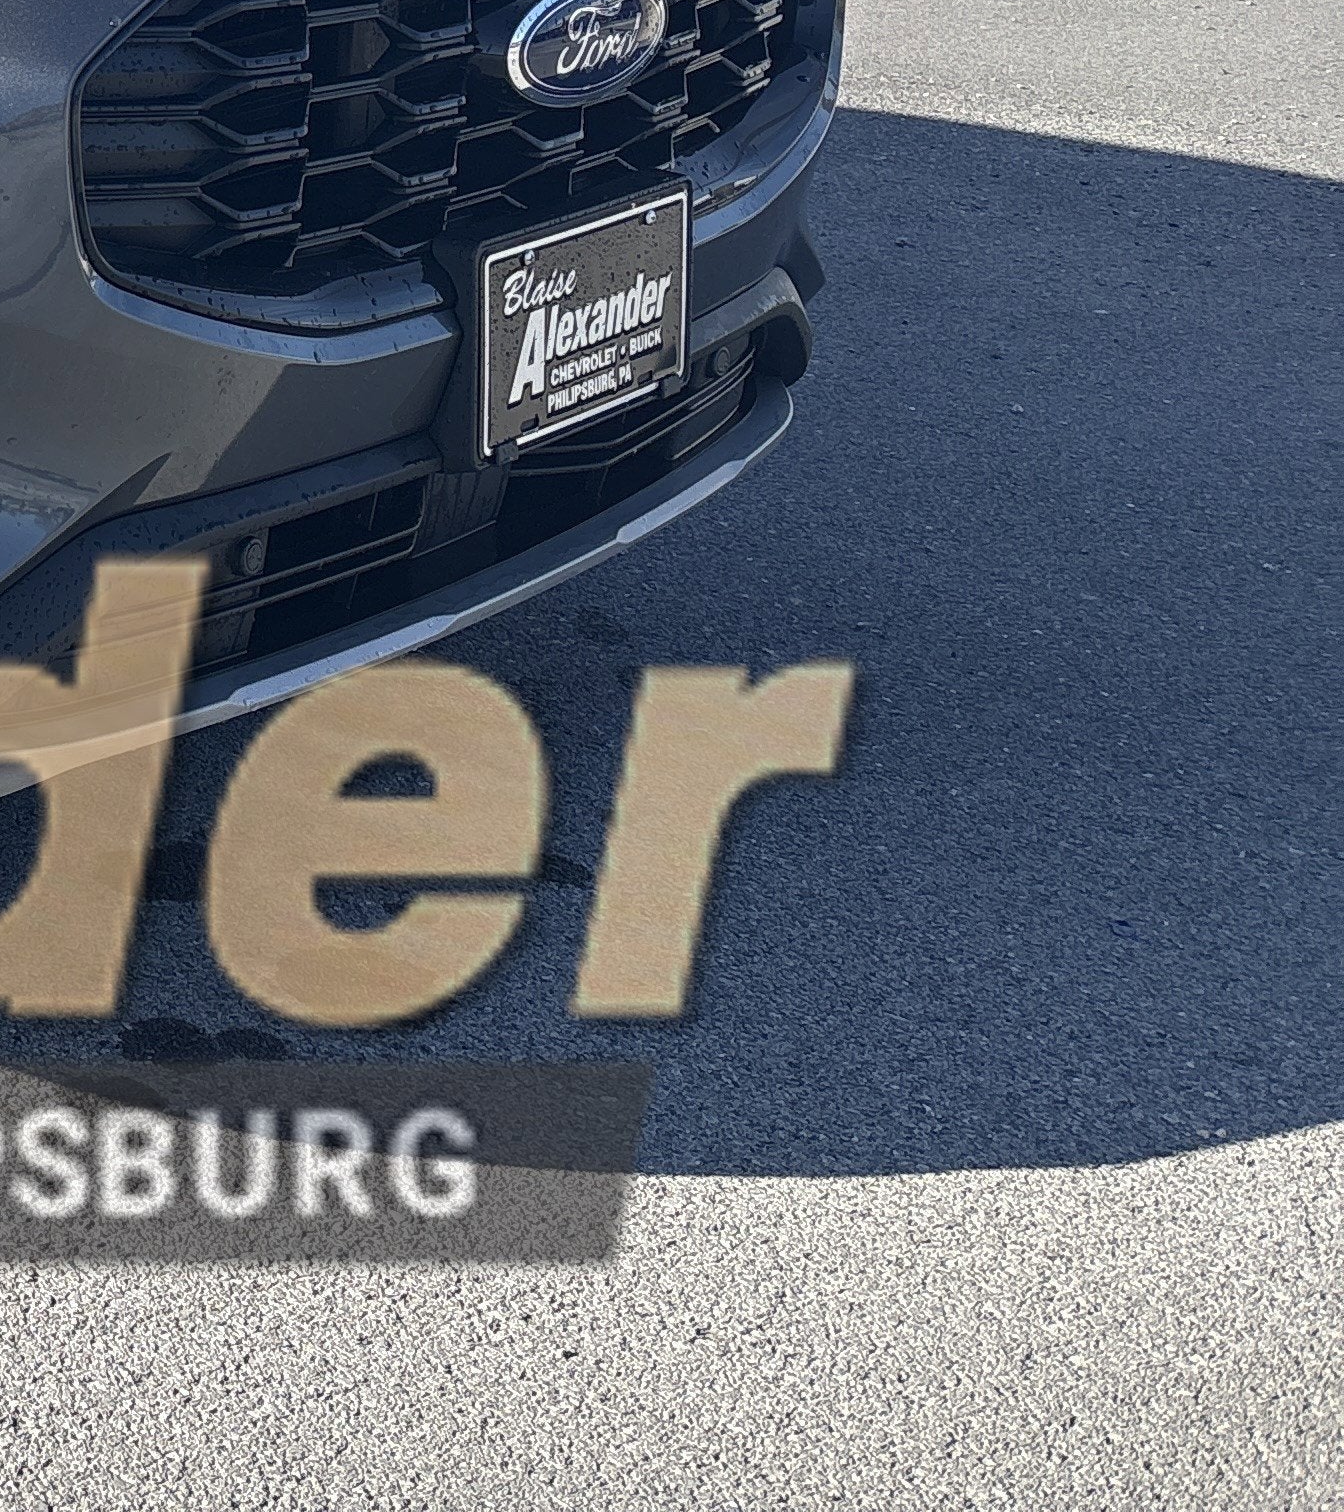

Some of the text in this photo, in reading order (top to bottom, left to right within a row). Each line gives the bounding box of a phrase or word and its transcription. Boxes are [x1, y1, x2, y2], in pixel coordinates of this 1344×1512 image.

[556, 1, 642, 75] Ford
[502, 267, 578, 317] Blaise
[507, 265, 673, 405] Alexander
[550, 328, 662, 386] CHEVROLET BUICK
[618, 363, 633, 383] PA
